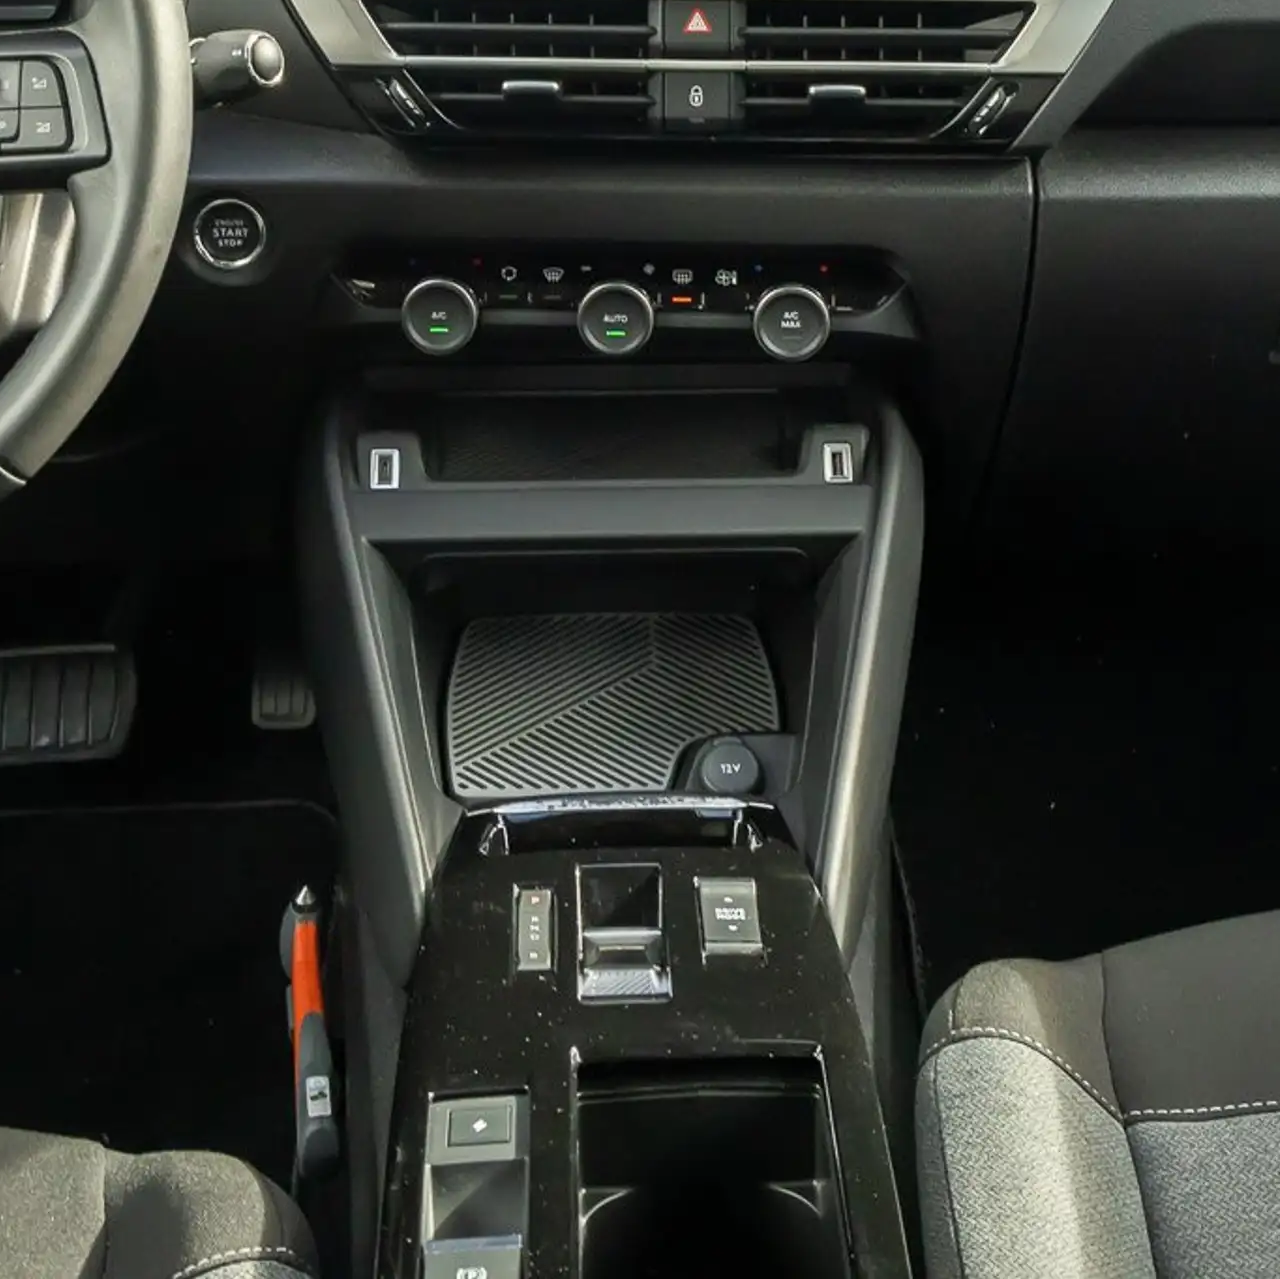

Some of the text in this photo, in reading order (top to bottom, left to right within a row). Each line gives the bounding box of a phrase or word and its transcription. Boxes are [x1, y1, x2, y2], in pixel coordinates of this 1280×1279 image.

[212, 227, 248, 238] START
[218, 239, 244, 248] STOP
[603, 313, 628, 324] AUTO
[780, 320, 801, 329] MAX
[720, 763, 741, 774] 12V
